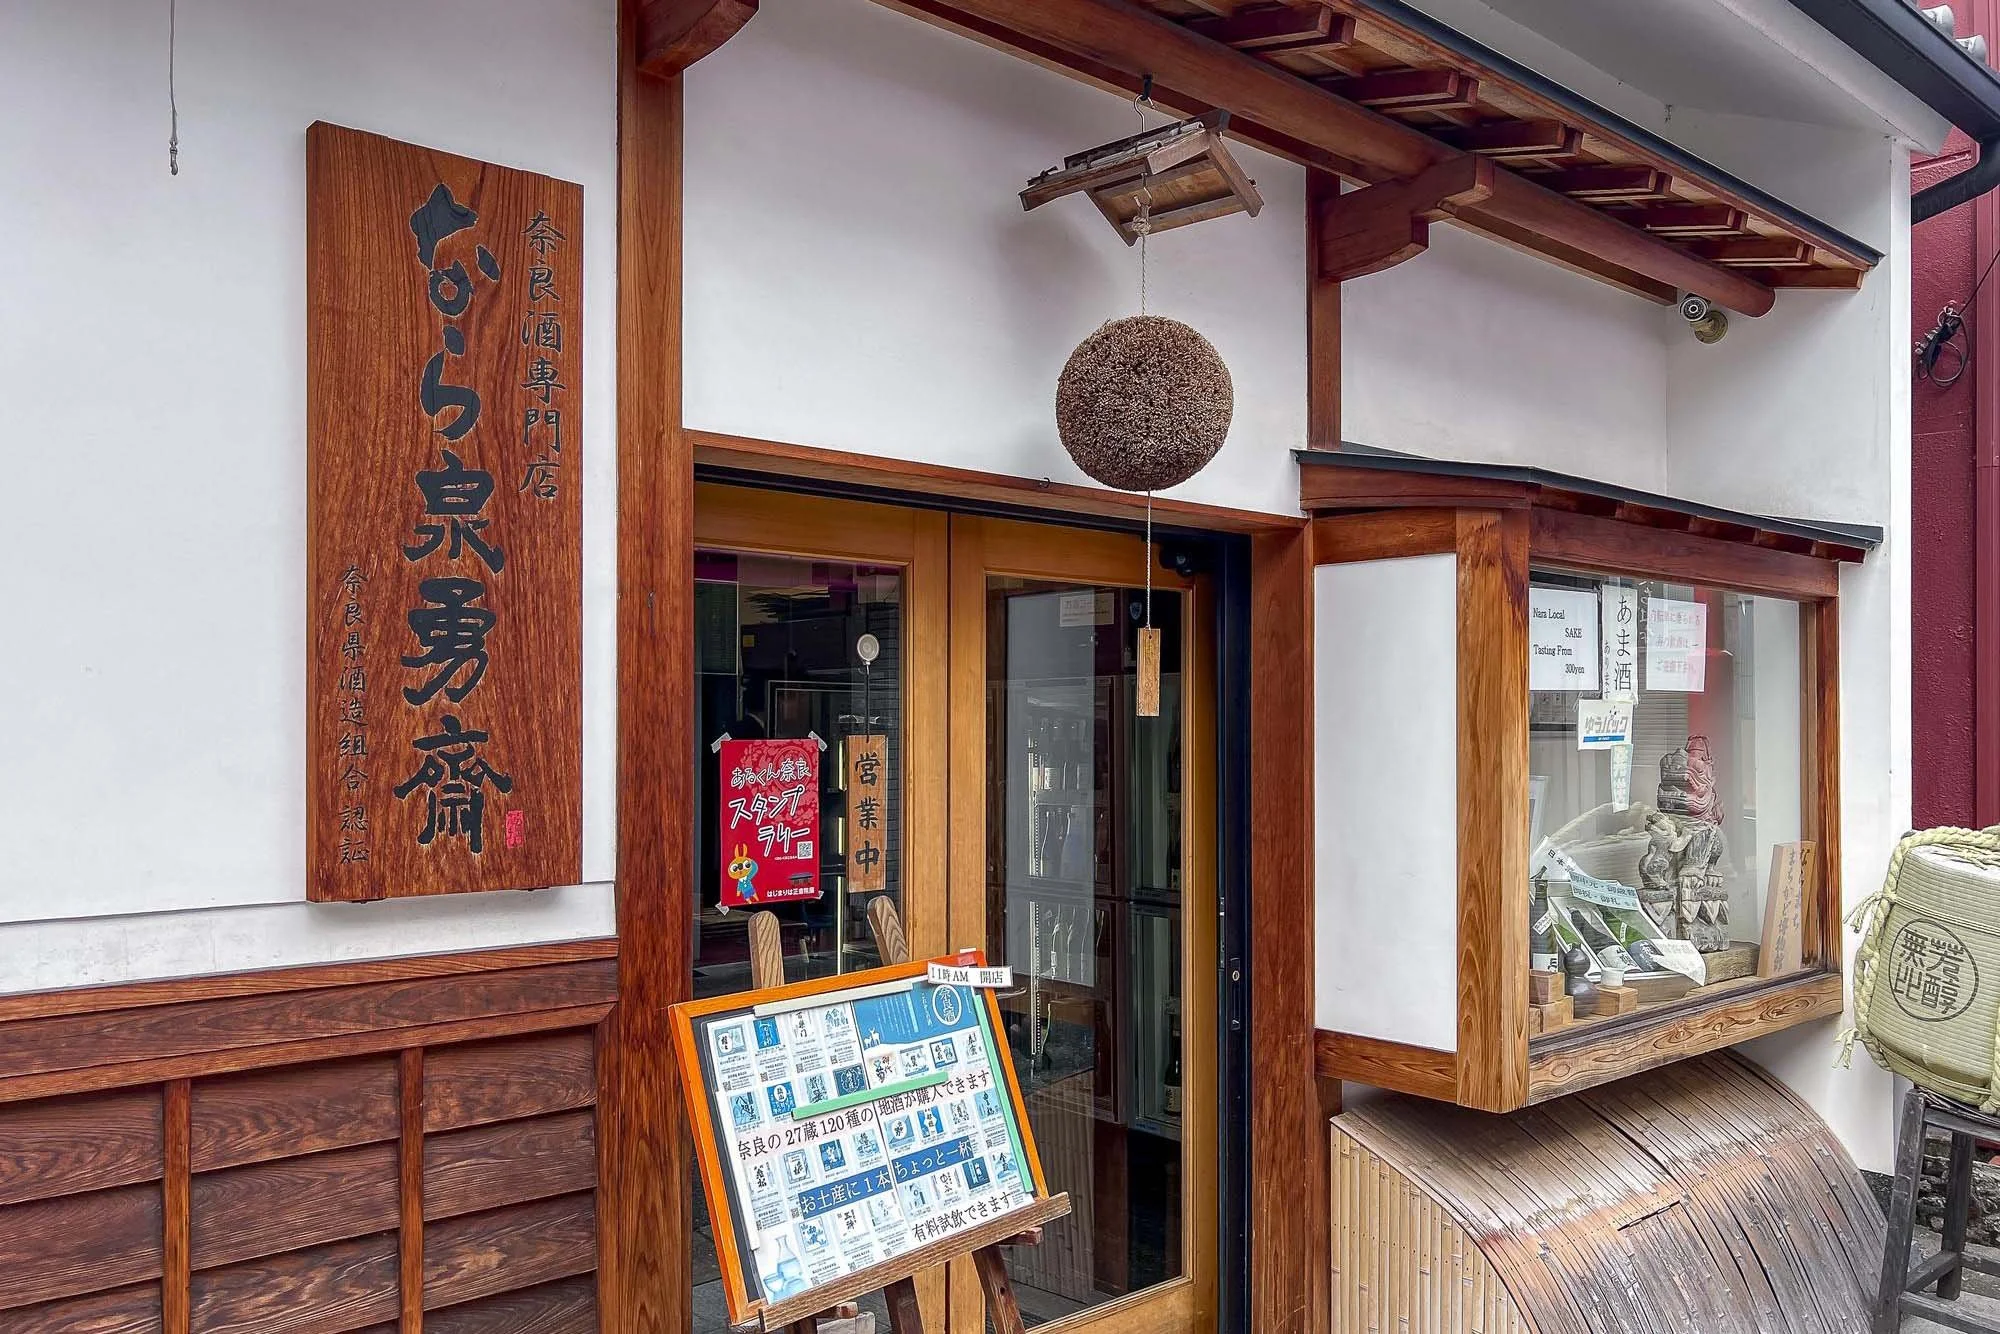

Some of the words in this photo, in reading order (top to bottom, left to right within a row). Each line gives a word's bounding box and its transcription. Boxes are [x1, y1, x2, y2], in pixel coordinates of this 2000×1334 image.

[519, 210, 566, 500] 奈良酒専門店
[1532, 607, 1548, 620] Nara
[1548, 608, 1565, 620] Local
[1565, 627, 1583, 639] SAKE
[1614, 595, 1632, 691] あま酒
[1533, 644, 1556, 657] Tasting
[1557, 645, 1573, 656] From
[1565, 664, 1585, 675] 300yen
[338, 564, 369, 865] 奈良県酒造組合認証
[1585, 714, 1628, 734] ゆうパック
[731, 757, 812, 789] あるくん奈良
[729, 785, 805, 829] スタンプ
[854, 752, 881, 875] 営業中
[757, 823, 811, 857] ラリー
[980, 970, 1003, 984] 開店
[894, 1140, 972, 1179] ちょっと一杯
[911, 1192, 1013, 1243] 有料試飲できます
